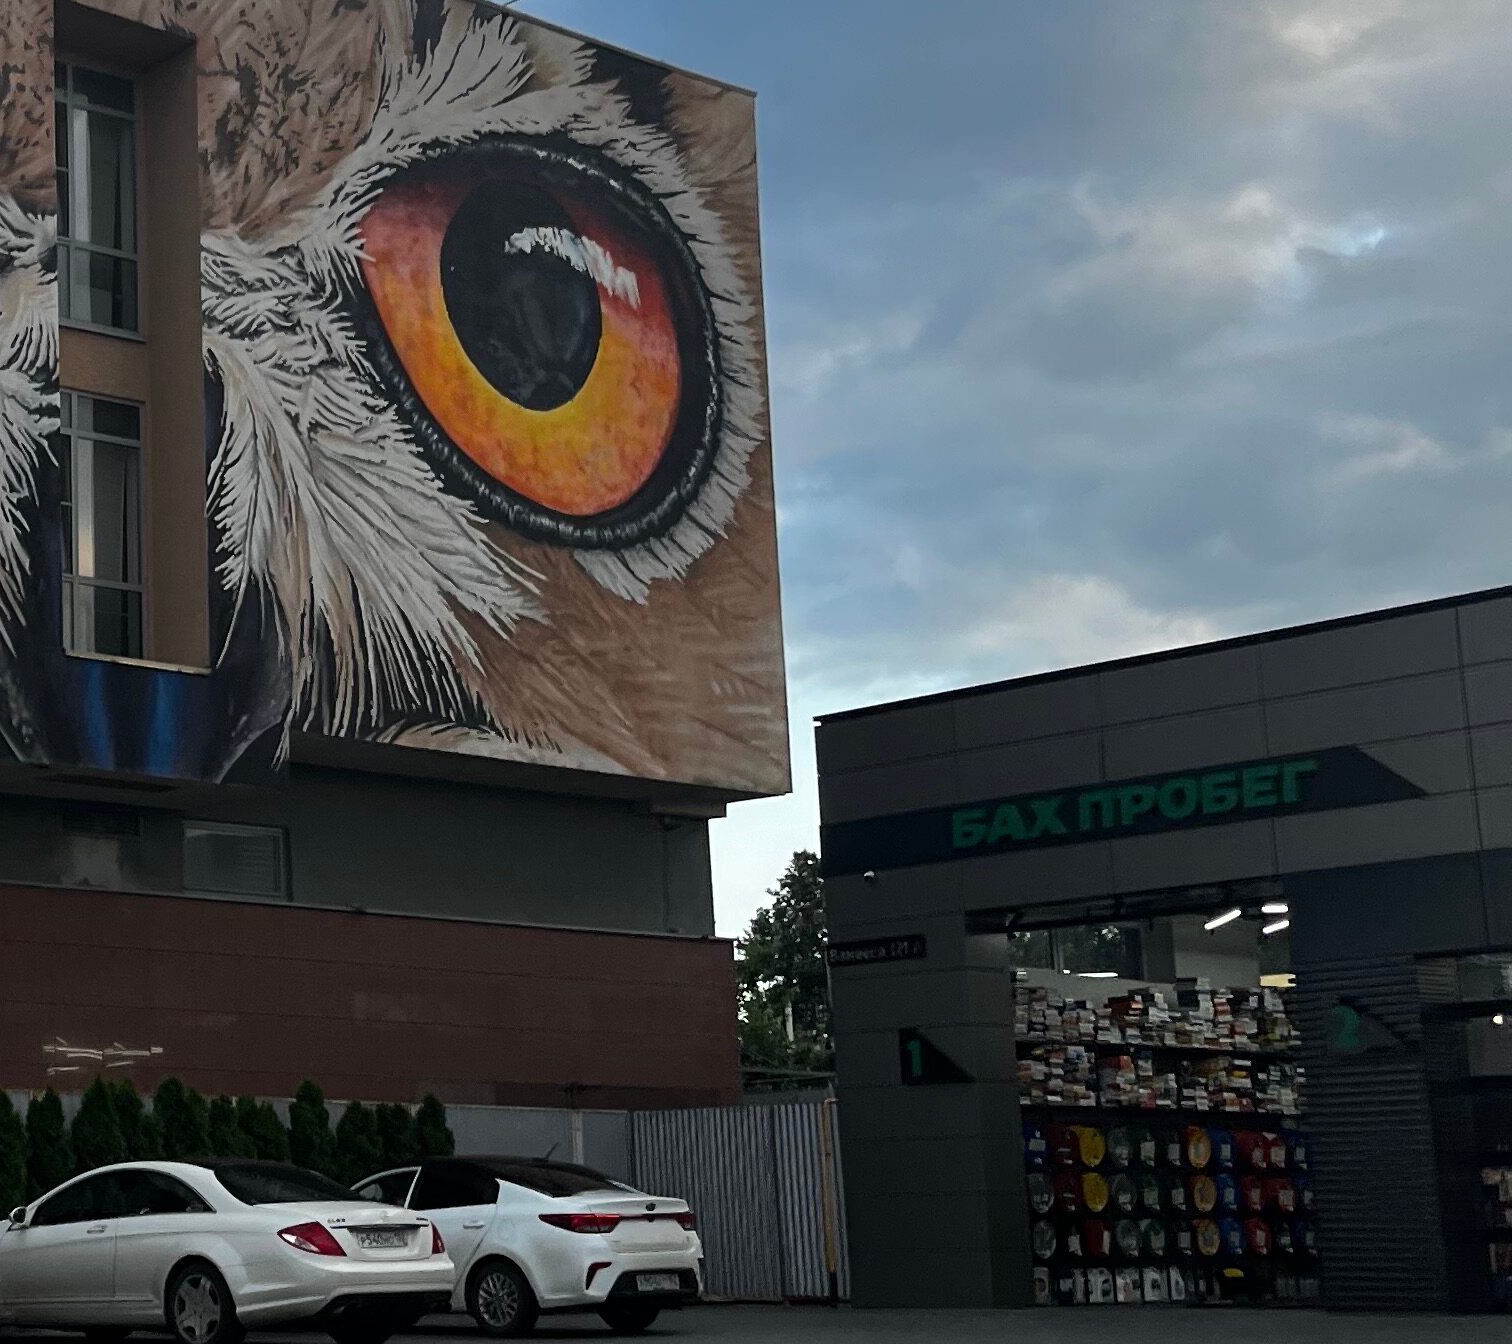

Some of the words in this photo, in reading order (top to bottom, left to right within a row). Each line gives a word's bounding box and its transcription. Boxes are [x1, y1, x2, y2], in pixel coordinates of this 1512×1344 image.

[951, 797, 1068, 849] БАХ
[1077, 757, 1320, 831] ПРОБЕГ
[1332, 1004, 1366, 1050] 2
[906, 1039, 923, 1077] 1
